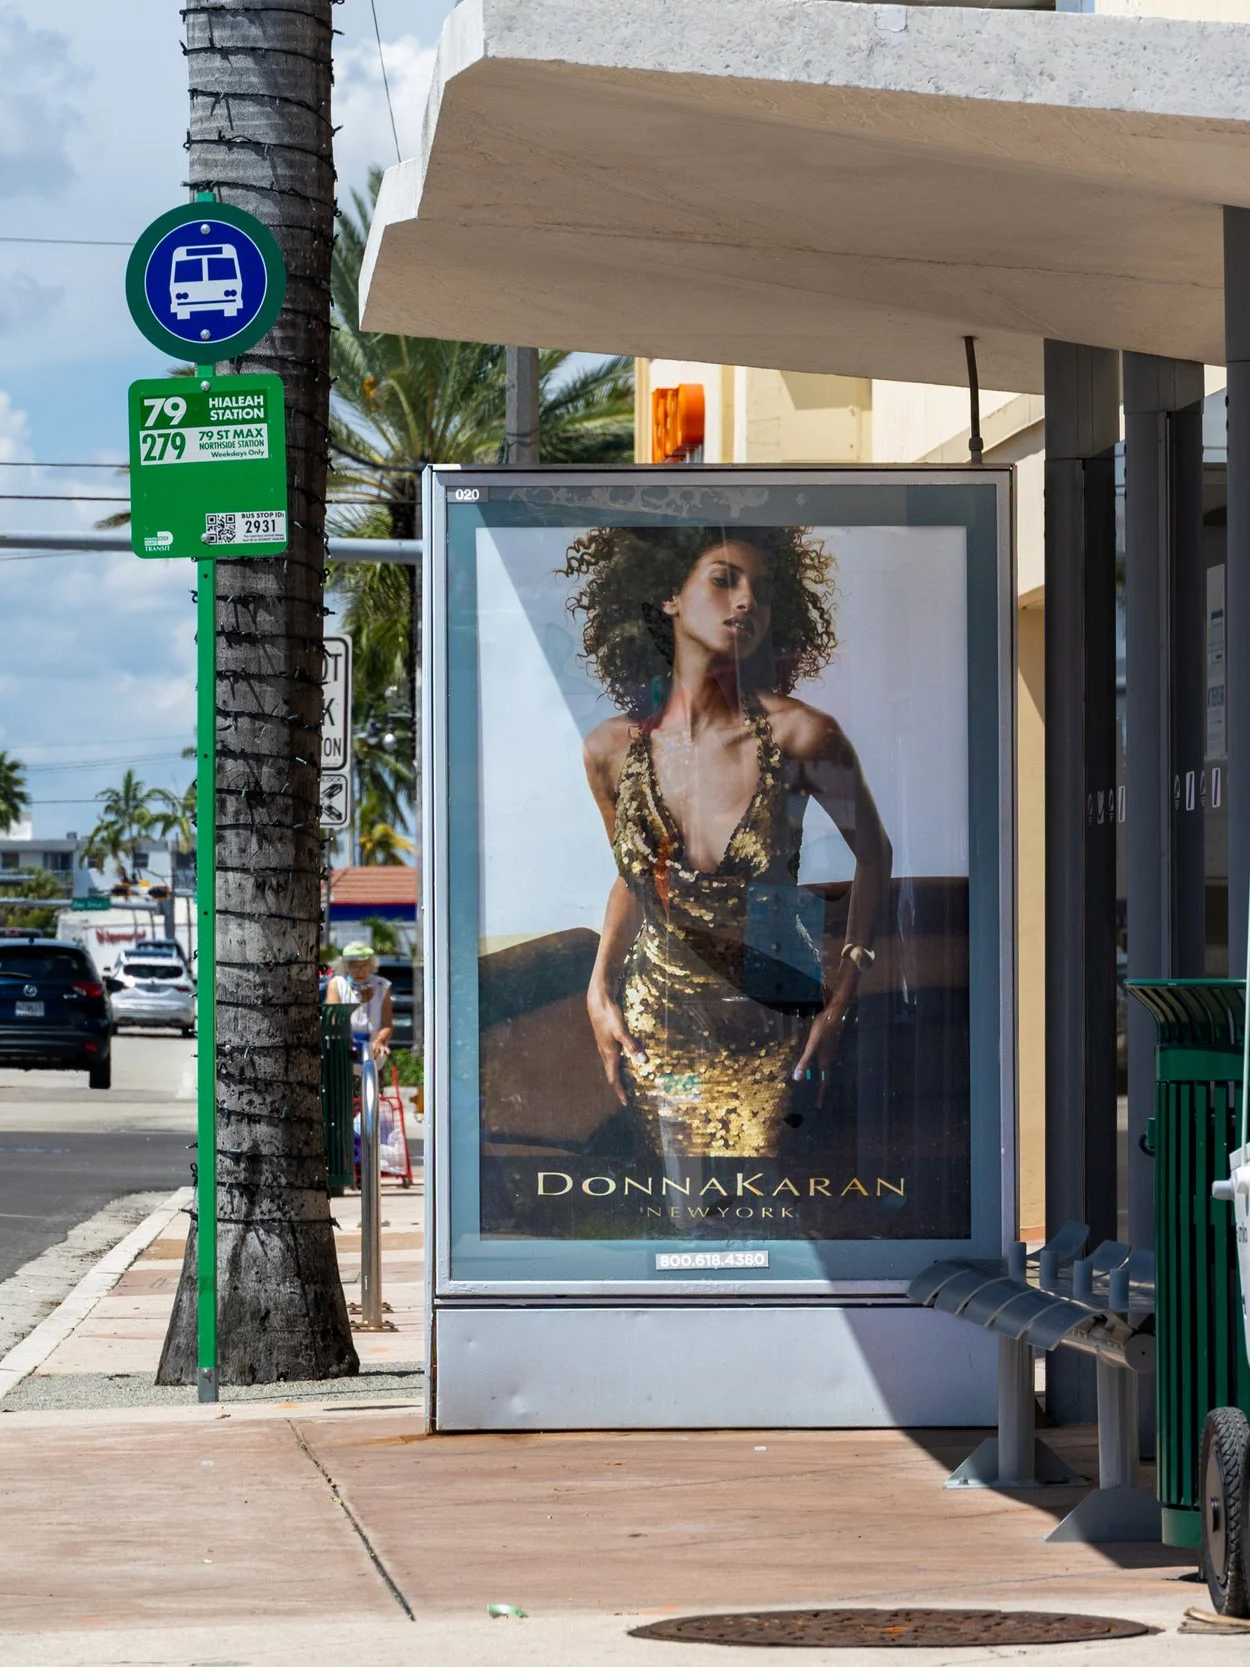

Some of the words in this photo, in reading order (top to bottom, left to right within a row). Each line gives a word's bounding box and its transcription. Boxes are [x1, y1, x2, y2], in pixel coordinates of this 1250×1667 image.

[208, 395, 264, 408] HIALEAH
[143, 396, 187, 427] 79
[210, 408, 264, 421] STATION
[198, 430, 214, 441] 79
[216, 429, 230, 440] ST
[233, 428, 263, 439] MAX
[142, 431, 186, 462] 279
[199, 441, 236, 451] NORTHSIDE
[237, 439, 264, 448] STATION
[211, 450, 247, 458] Weekdays
[455, 489, 480, 501] 020
[244, 520, 276, 534] 2931
[659, 1253, 766, 1269] 800.618.4380
